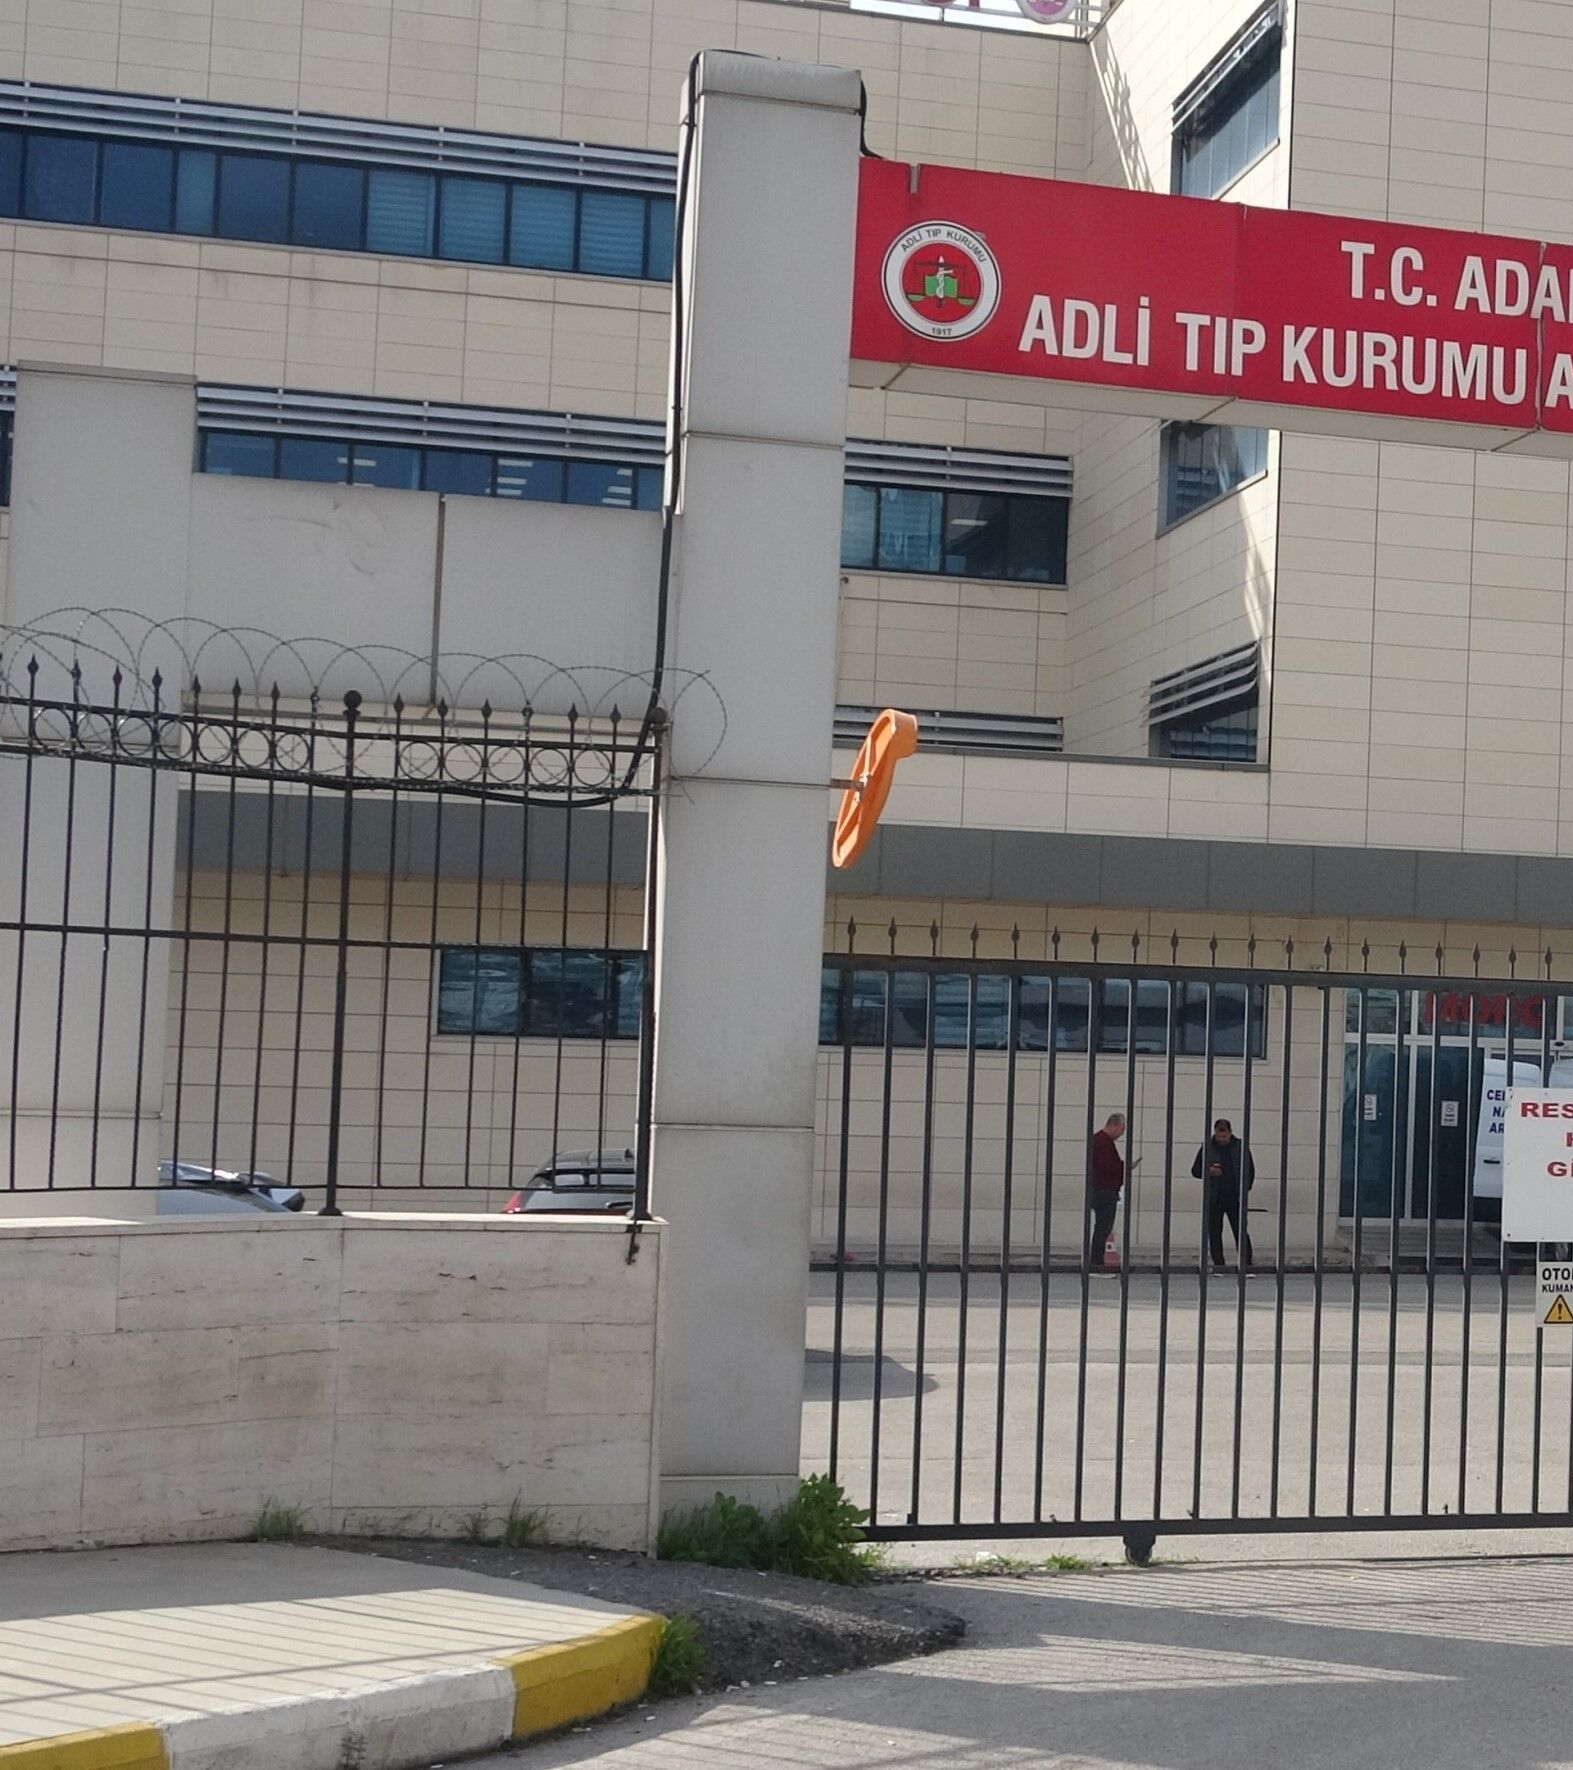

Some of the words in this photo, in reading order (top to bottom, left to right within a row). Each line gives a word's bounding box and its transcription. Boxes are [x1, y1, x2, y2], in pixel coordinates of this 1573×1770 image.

[901, 230, 923, 252] ADLİ
[926, 228, 942, 238] TIP
[946, 230, 987, 263] KURUMU
[1342, 241, 1437, 306] T.C.
[1019, 294, 1151, 365] ADLİ
[1175, 313, 1266, 376] TIP
[1283, 325, 1527, 404] KURUMU
